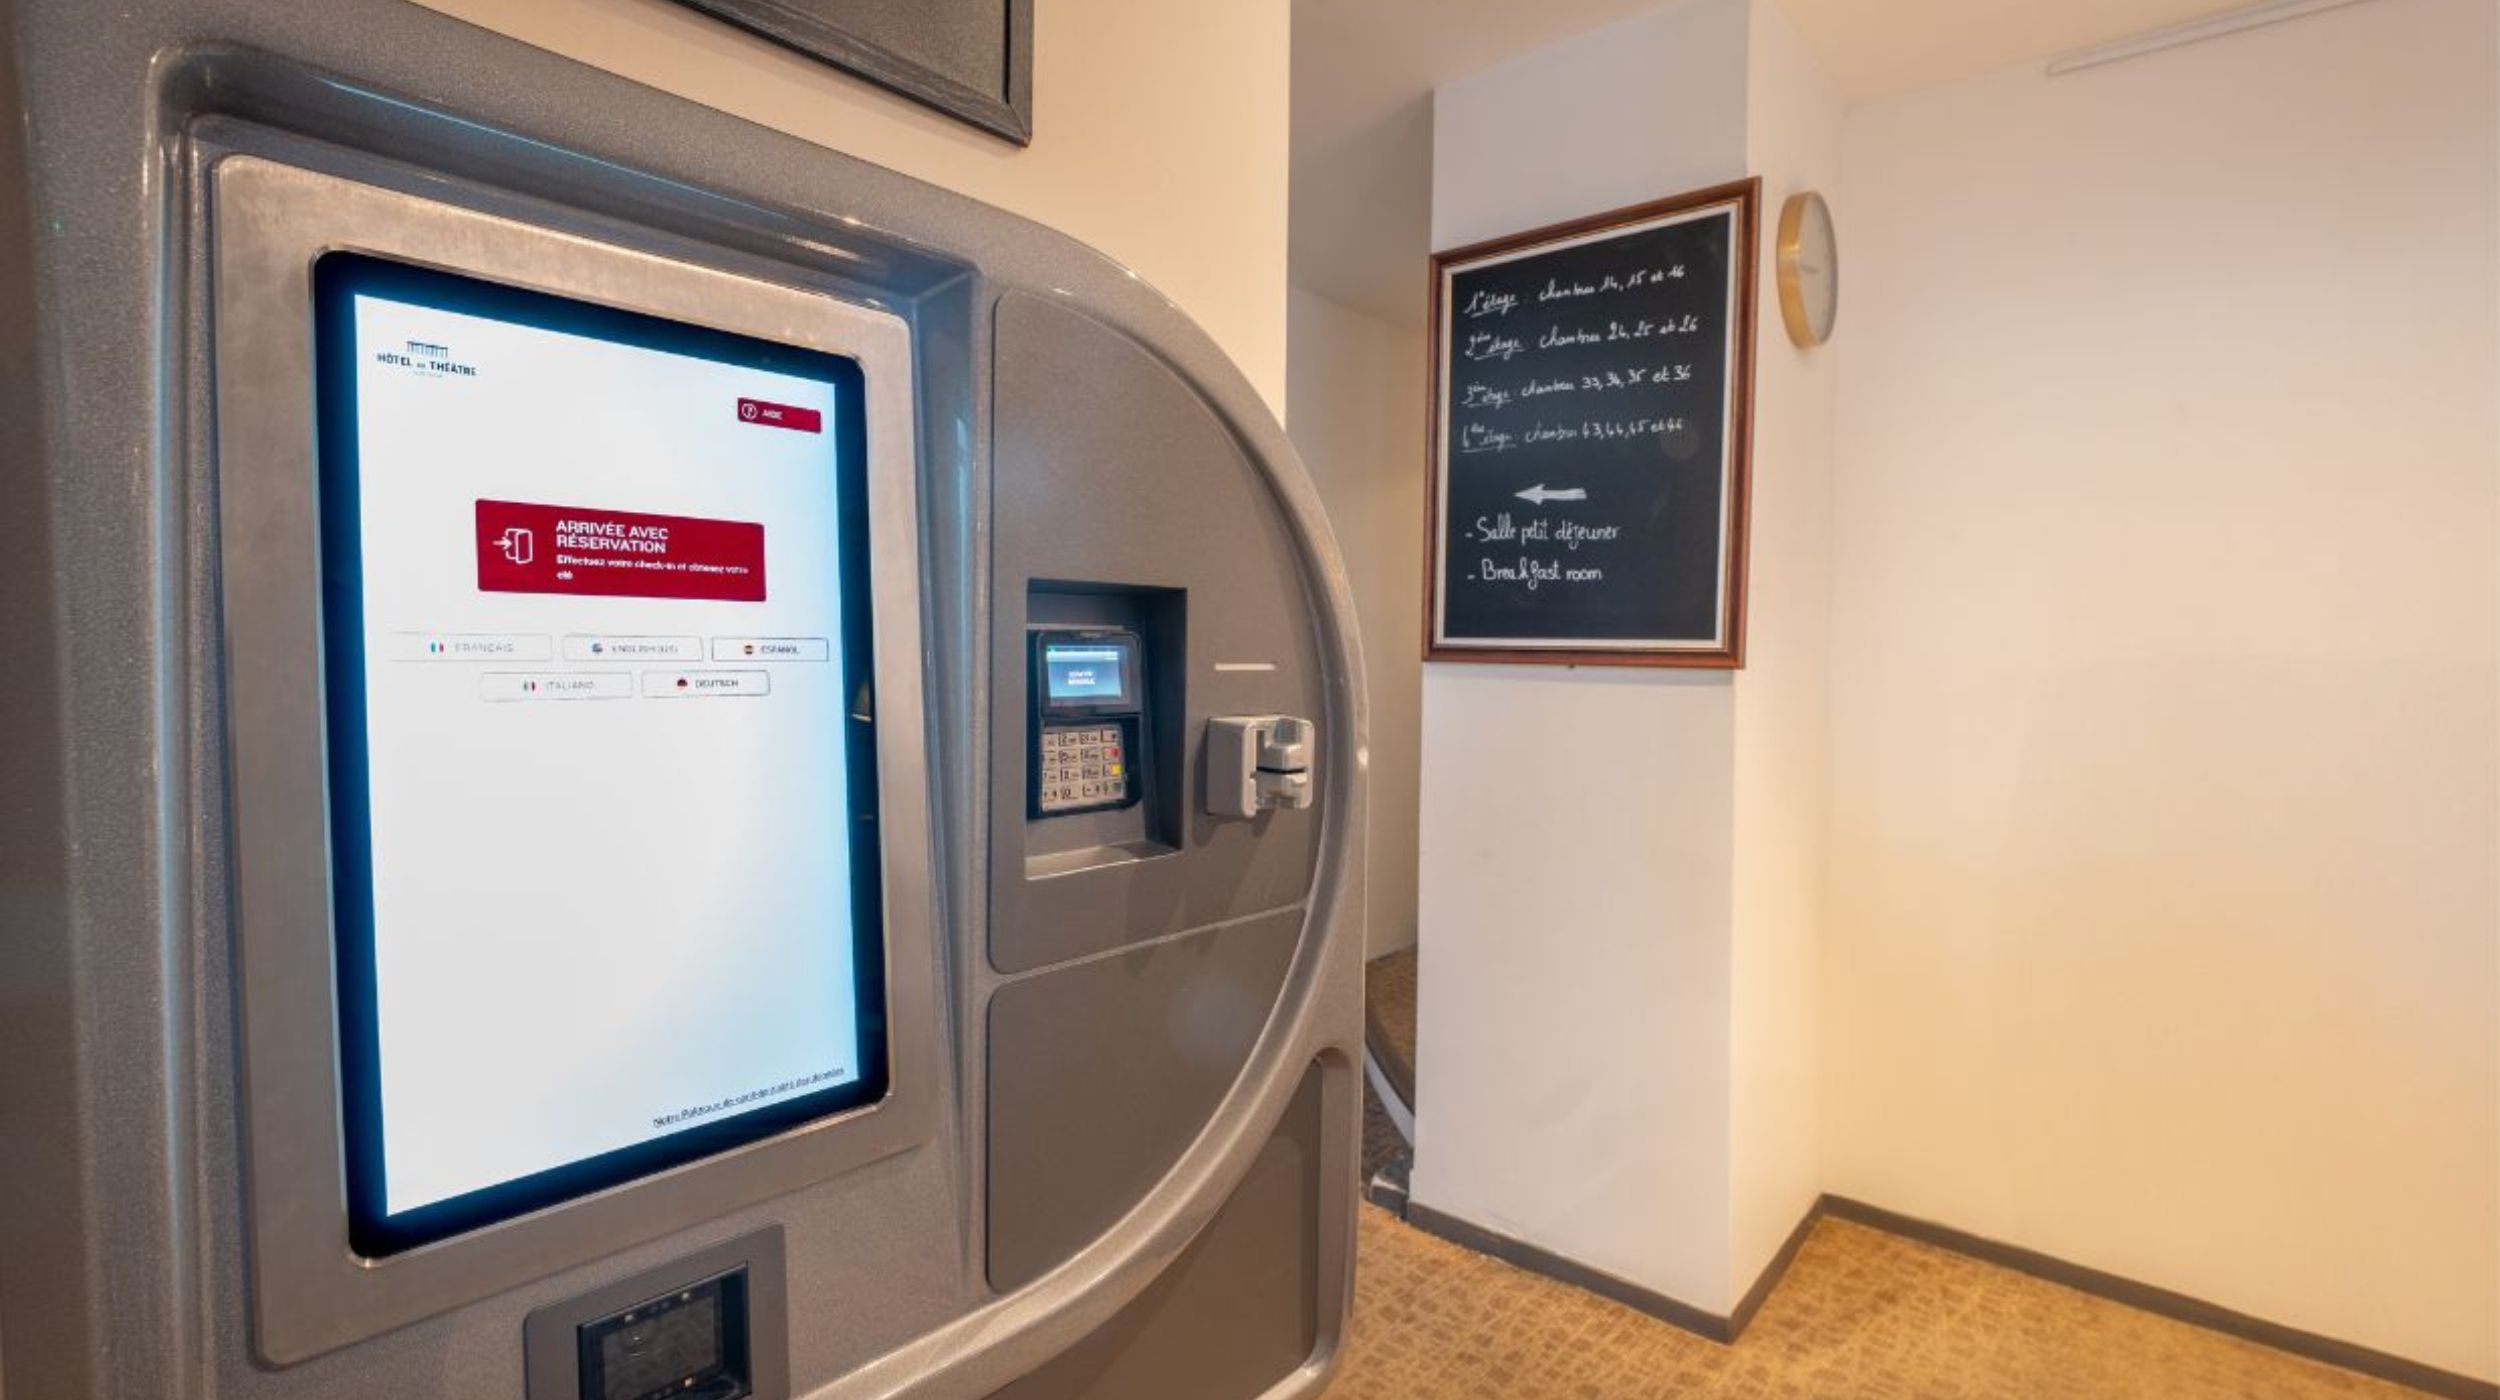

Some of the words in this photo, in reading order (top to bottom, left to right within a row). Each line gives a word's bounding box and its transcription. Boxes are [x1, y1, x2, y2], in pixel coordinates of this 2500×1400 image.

[1652, 365, 1671, 383] et
[556, 520, 627, 538] ARRIVÉE
[628, 525, 669, 541] AVEC
[1476, 513, 1517, 543] Salle
[1521, 518, 1550, 546] petit
[1554, 519, 1622, 550] déjeuner
[556, 534, 668, 554] RÉSERVATION
[1481, 556, 1562, 591] Breakfast
[1566, 565, 1603, 581] room
